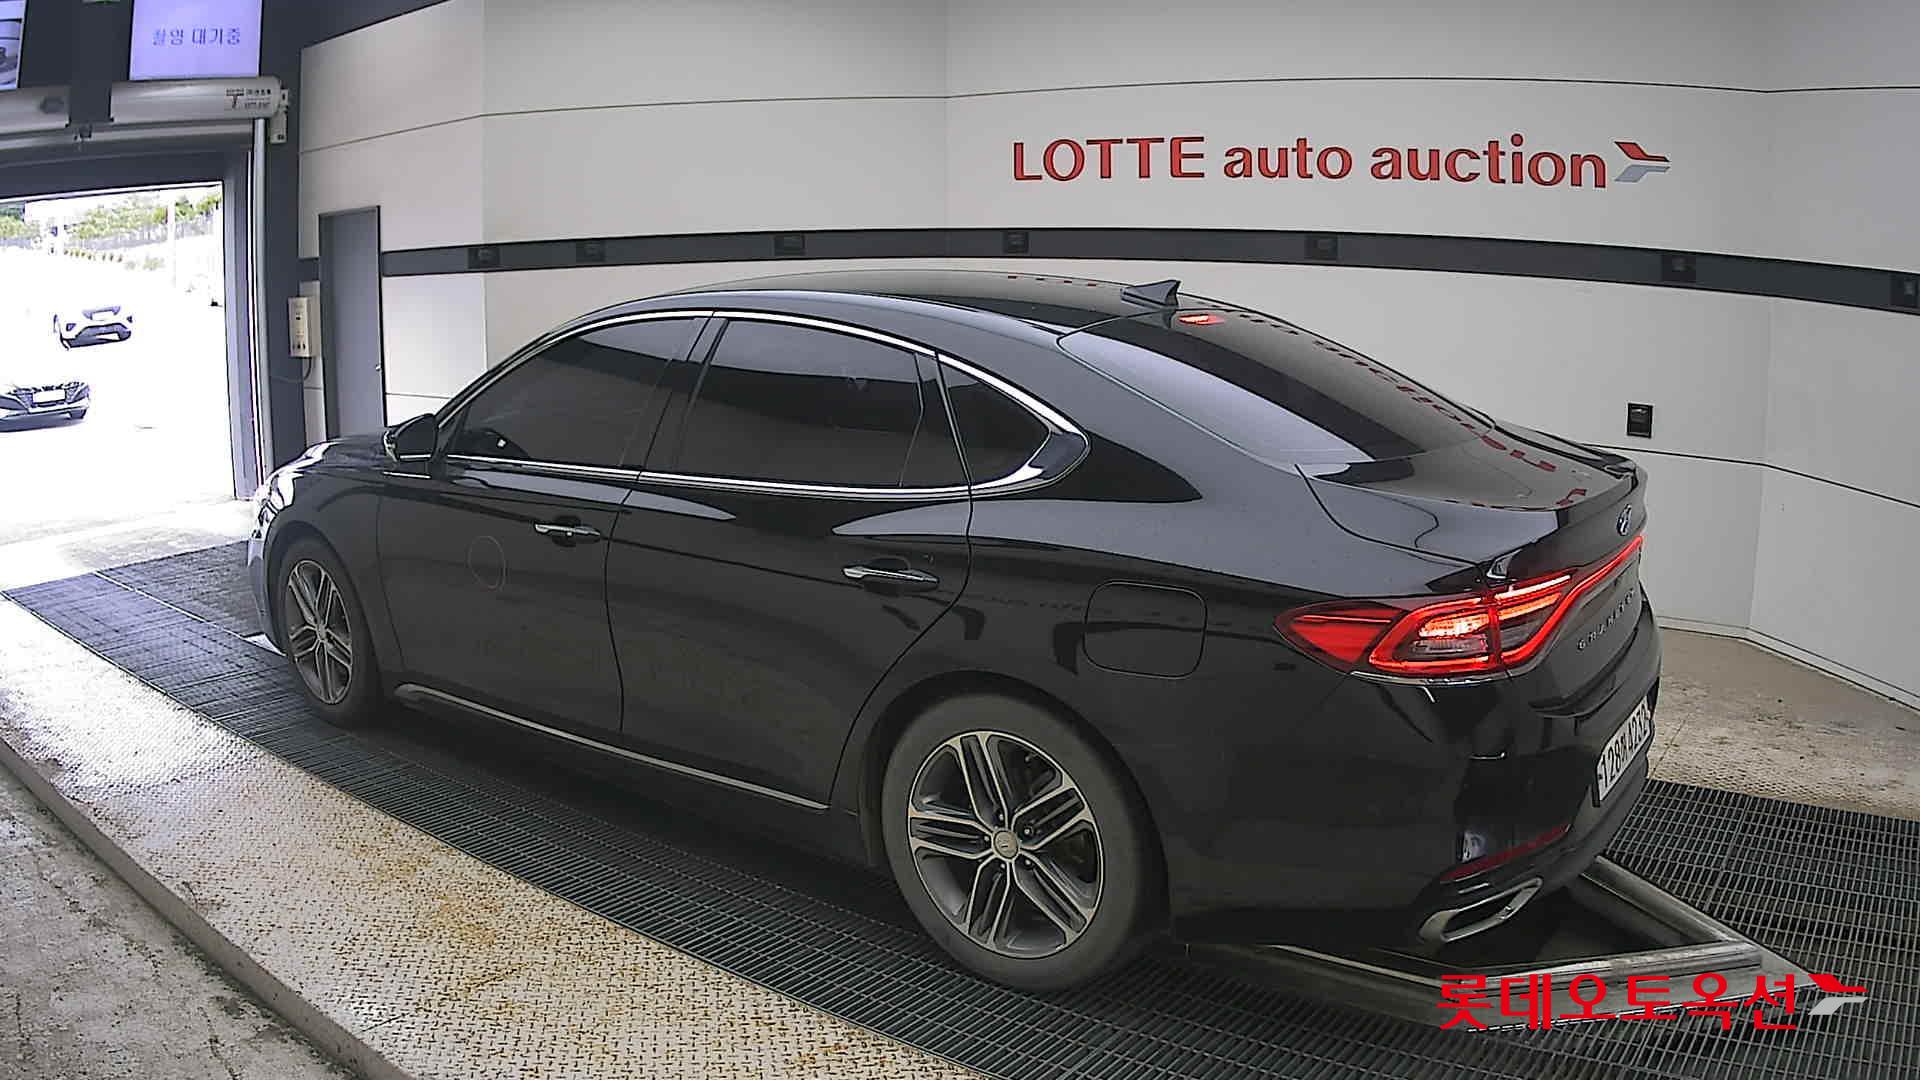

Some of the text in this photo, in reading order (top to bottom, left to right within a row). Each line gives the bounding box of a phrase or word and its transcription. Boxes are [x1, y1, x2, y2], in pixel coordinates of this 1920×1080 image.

[191, 27, 241, 46] 대기중
[1013, 133, 1607, 189] LOTTE auto auction
